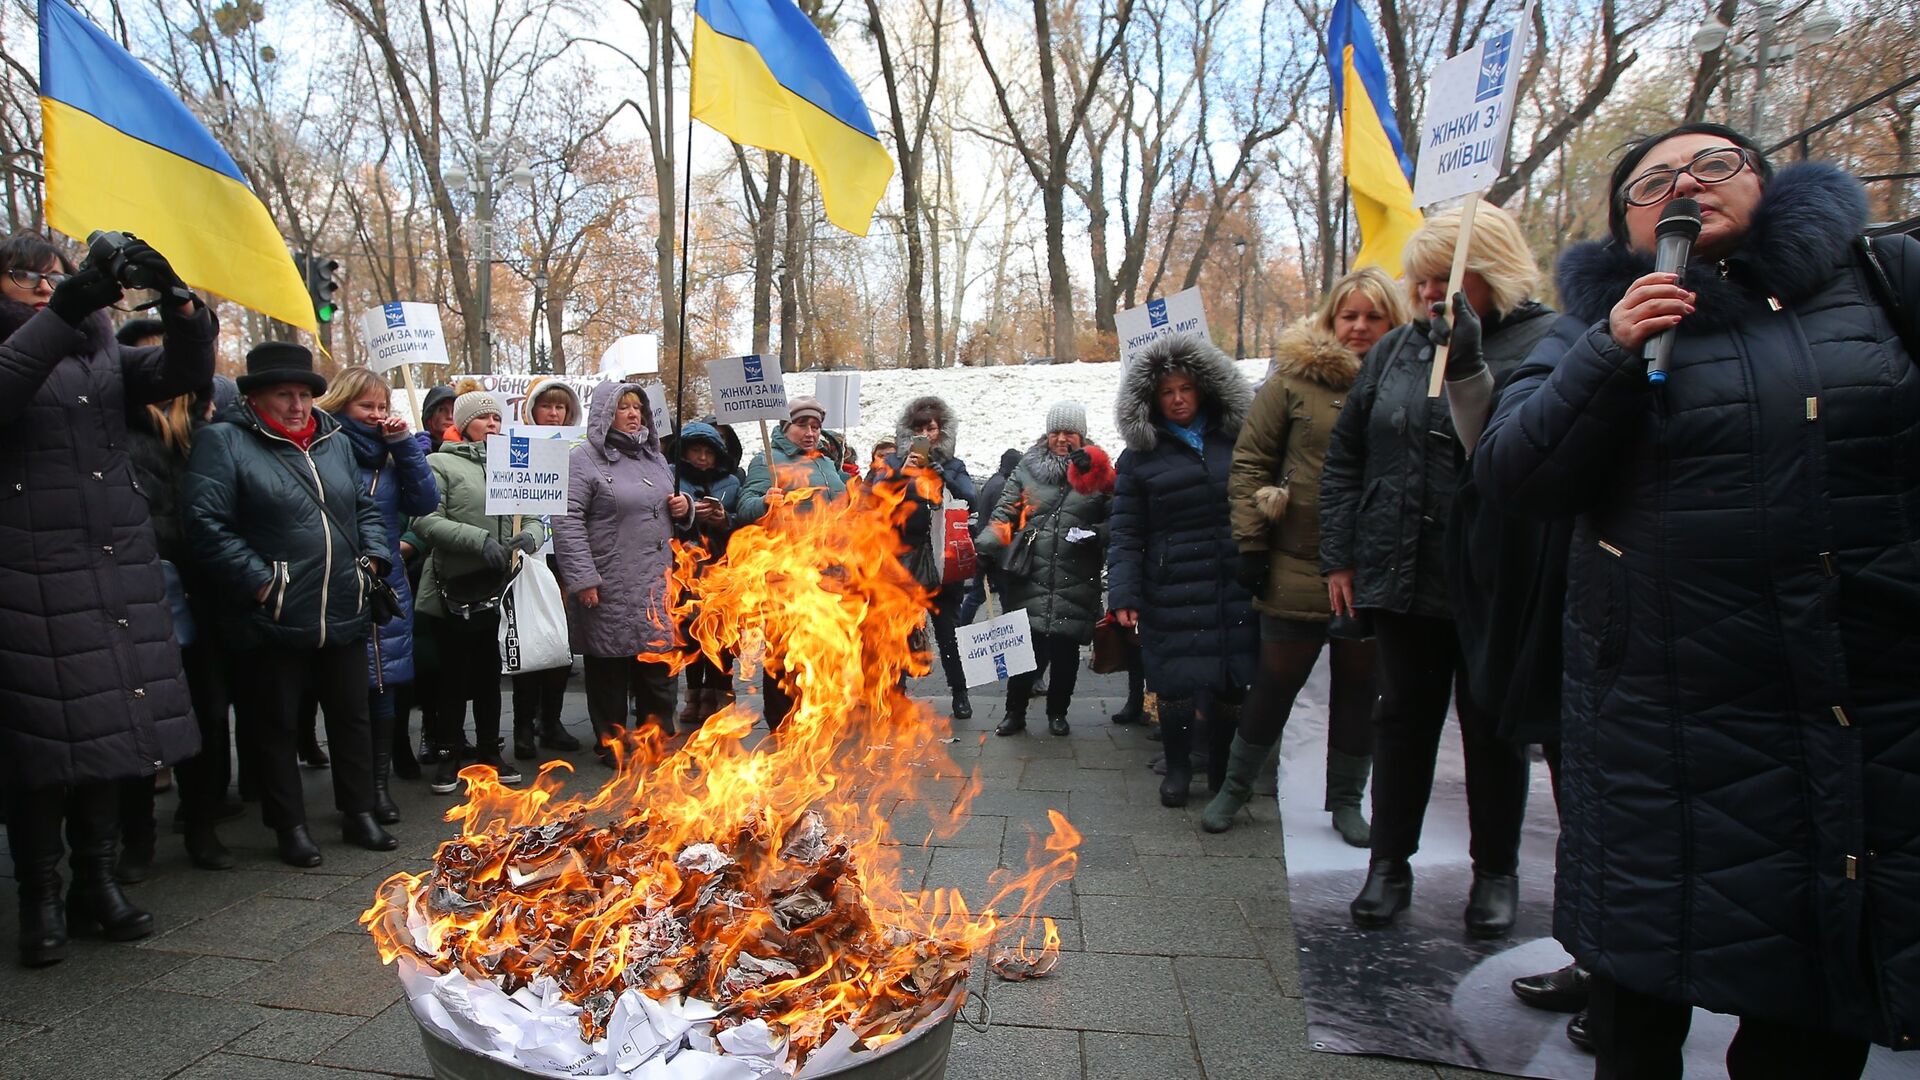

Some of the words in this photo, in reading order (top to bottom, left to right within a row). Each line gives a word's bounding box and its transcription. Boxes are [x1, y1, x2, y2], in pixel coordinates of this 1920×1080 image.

[1430, 110, 1480, 148] ЖІНКИ
[396, 328, 411, 340] ЗА
[414, 328, 435, 339] МИР
[1127, 331, 1158, 349] ЖІНКИ
[1176, 317, 1198, 333] МИР
[379, 342, 428, 359] ОДЕЩИНИ
[720, 384, 753, 399] ЖІНКИ
[755, 383, 769, 395] ЗА
[492, 471, 514, 483] ЖІНКИ
[516, 472, 531, 483] ЗА
[534, 473, 559, 485] МИР
[490, 486, 562, 501] МИКОЛАЇВЩИНИ
[968, 648, 988, 660] МИР
